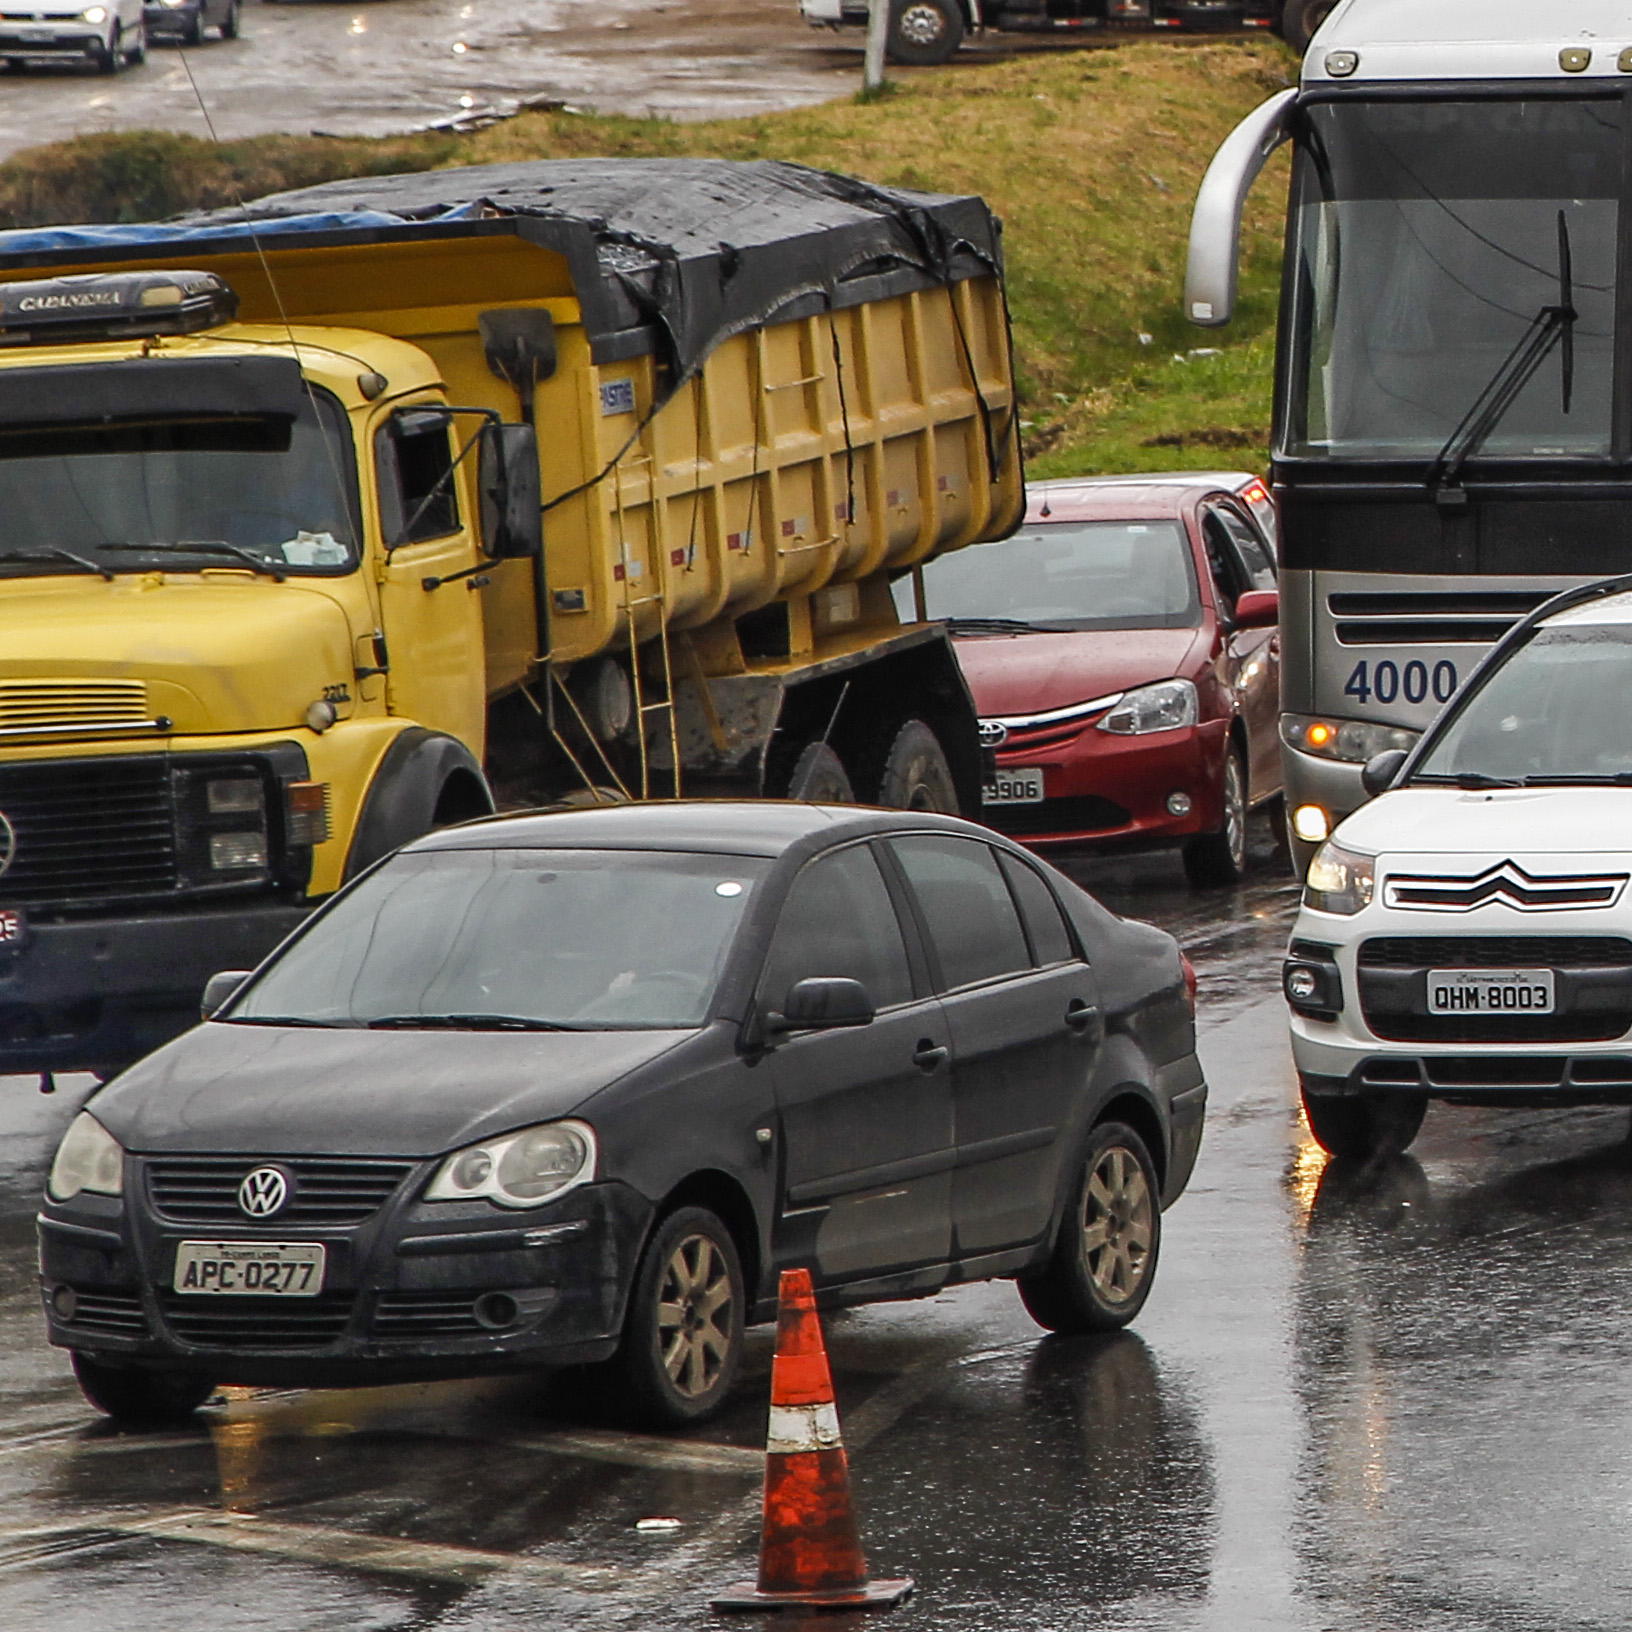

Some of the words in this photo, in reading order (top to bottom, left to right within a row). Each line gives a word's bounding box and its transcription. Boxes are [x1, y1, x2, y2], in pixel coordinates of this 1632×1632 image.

[1343, 659, 1458, 704] 4000
[1435, 986, 1548, 1009] QHM-8003
[183, 1260, 316, 1290] APC-0277
